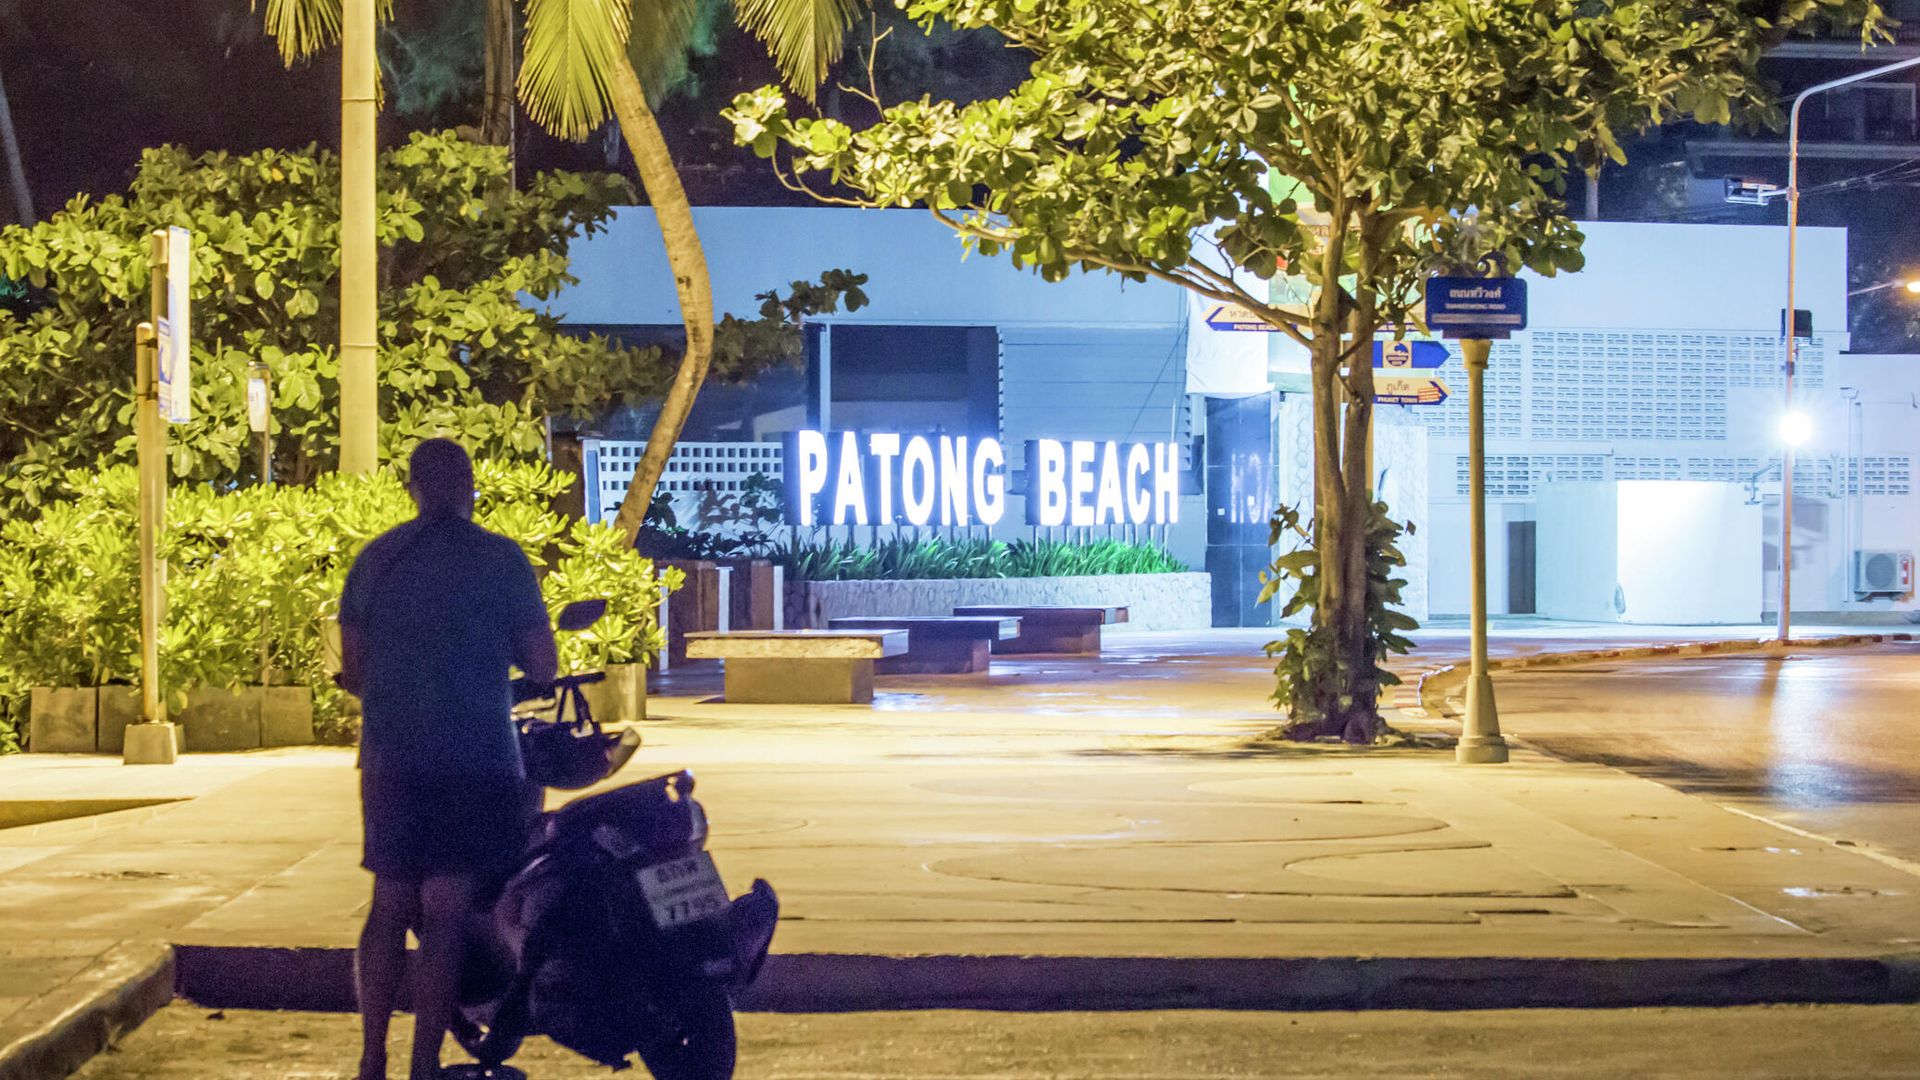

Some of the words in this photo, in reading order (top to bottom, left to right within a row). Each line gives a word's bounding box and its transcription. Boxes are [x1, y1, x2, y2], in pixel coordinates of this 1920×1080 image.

[1386, 380, 1410, 395] ภูเก็ต
[798, 429, 1005, 527] PATONG
[1038, 438, 1179, 527] BEACH
